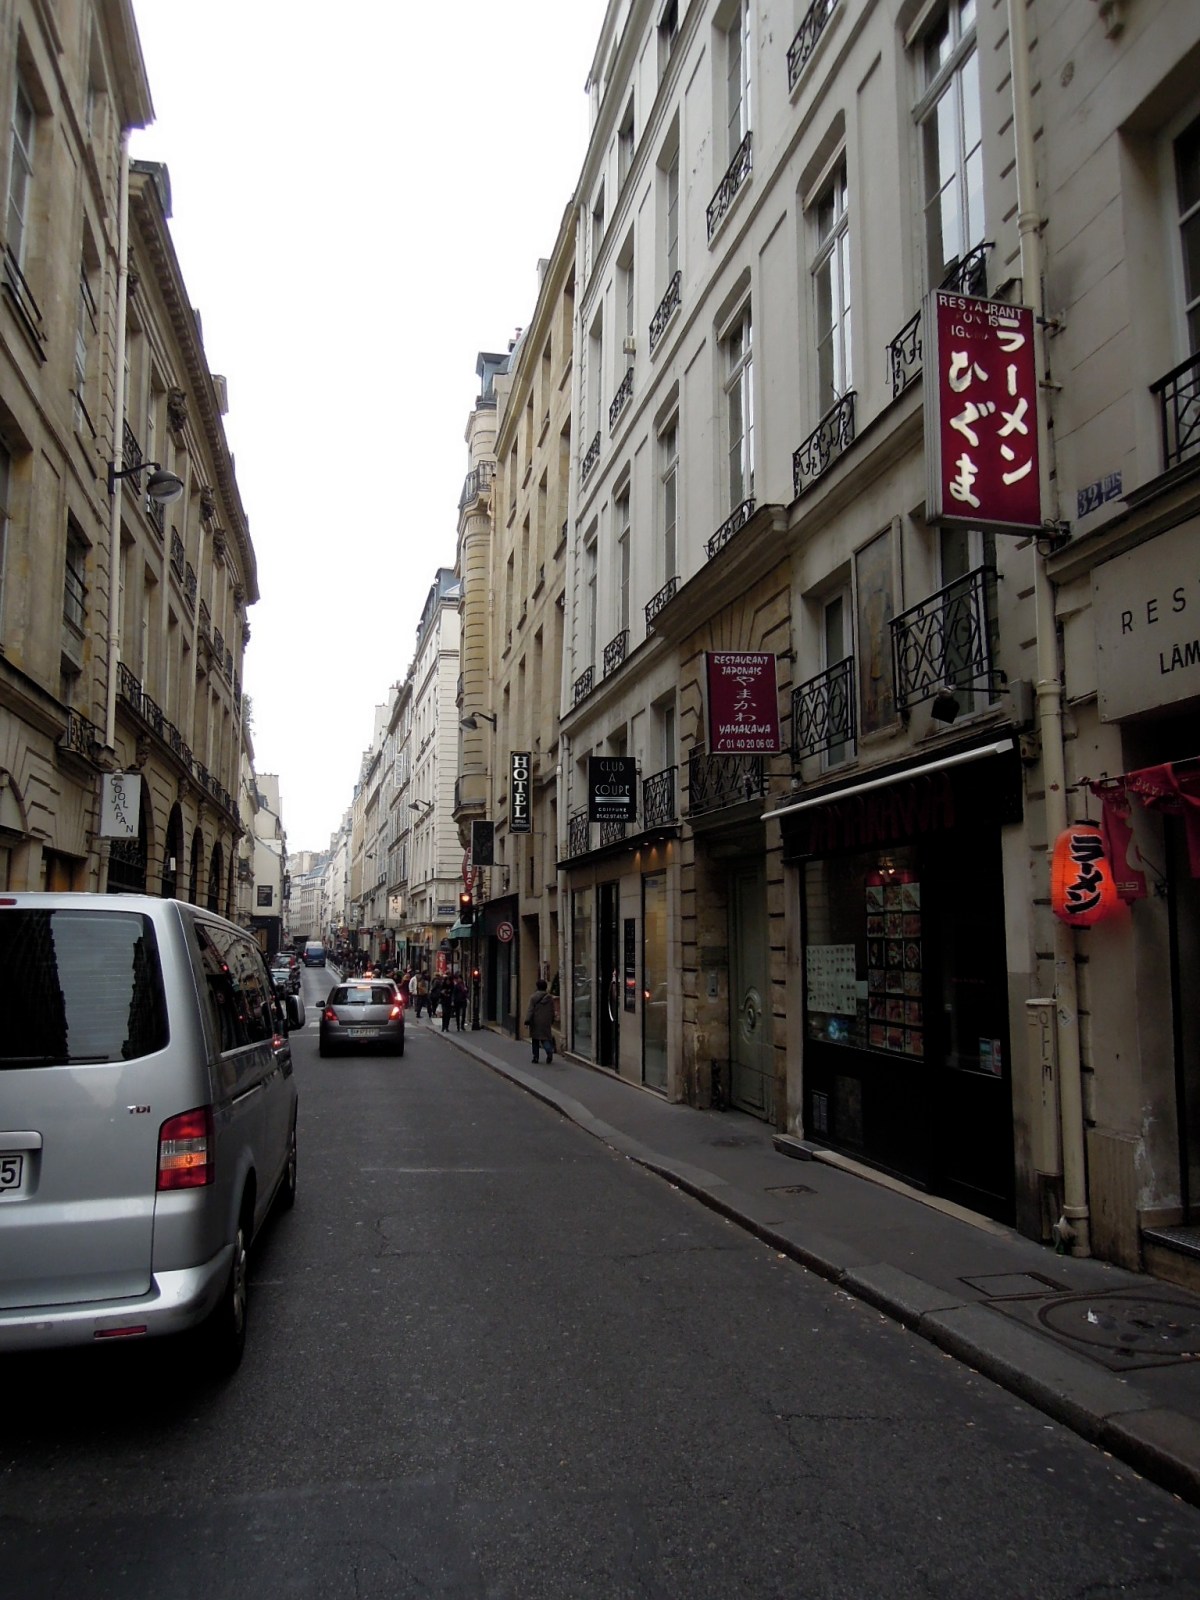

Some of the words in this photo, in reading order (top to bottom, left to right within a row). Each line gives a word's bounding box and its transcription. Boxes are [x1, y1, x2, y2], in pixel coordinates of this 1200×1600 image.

[996, 317, 1033, 486] ラーメン
[948, 350, 997, 509] ひぐま
[1078, 484, 1099, 515] 32
[1121, 579, 1200, 635] RES
[713, 655, 769, 665] RESTAURANT
[720, 666, 762, 675] JAPONAIS
[732, 675, 757, 722] やまかわ
[718, 724, 771, 735] YAMAKAWA
[726, 738, 735, 748] 01
[736, 738, 745, 748] 40
[746, 738, 755, 748] 20
[599, 760, 625, 772] CLUB
[608, 772, 616, 783] A
[110, 777, 129, 809] COOL
[513, 755, 528, 818] HOTEL
[594, 784, 630, 796] COUPE
[111, 795, 134, 833] JAPAN
[1065, 833, 1105, 914] ラーメン
[126, 1105, 151, 1115] TDI
[0, 1159, 17, 1184] 5
